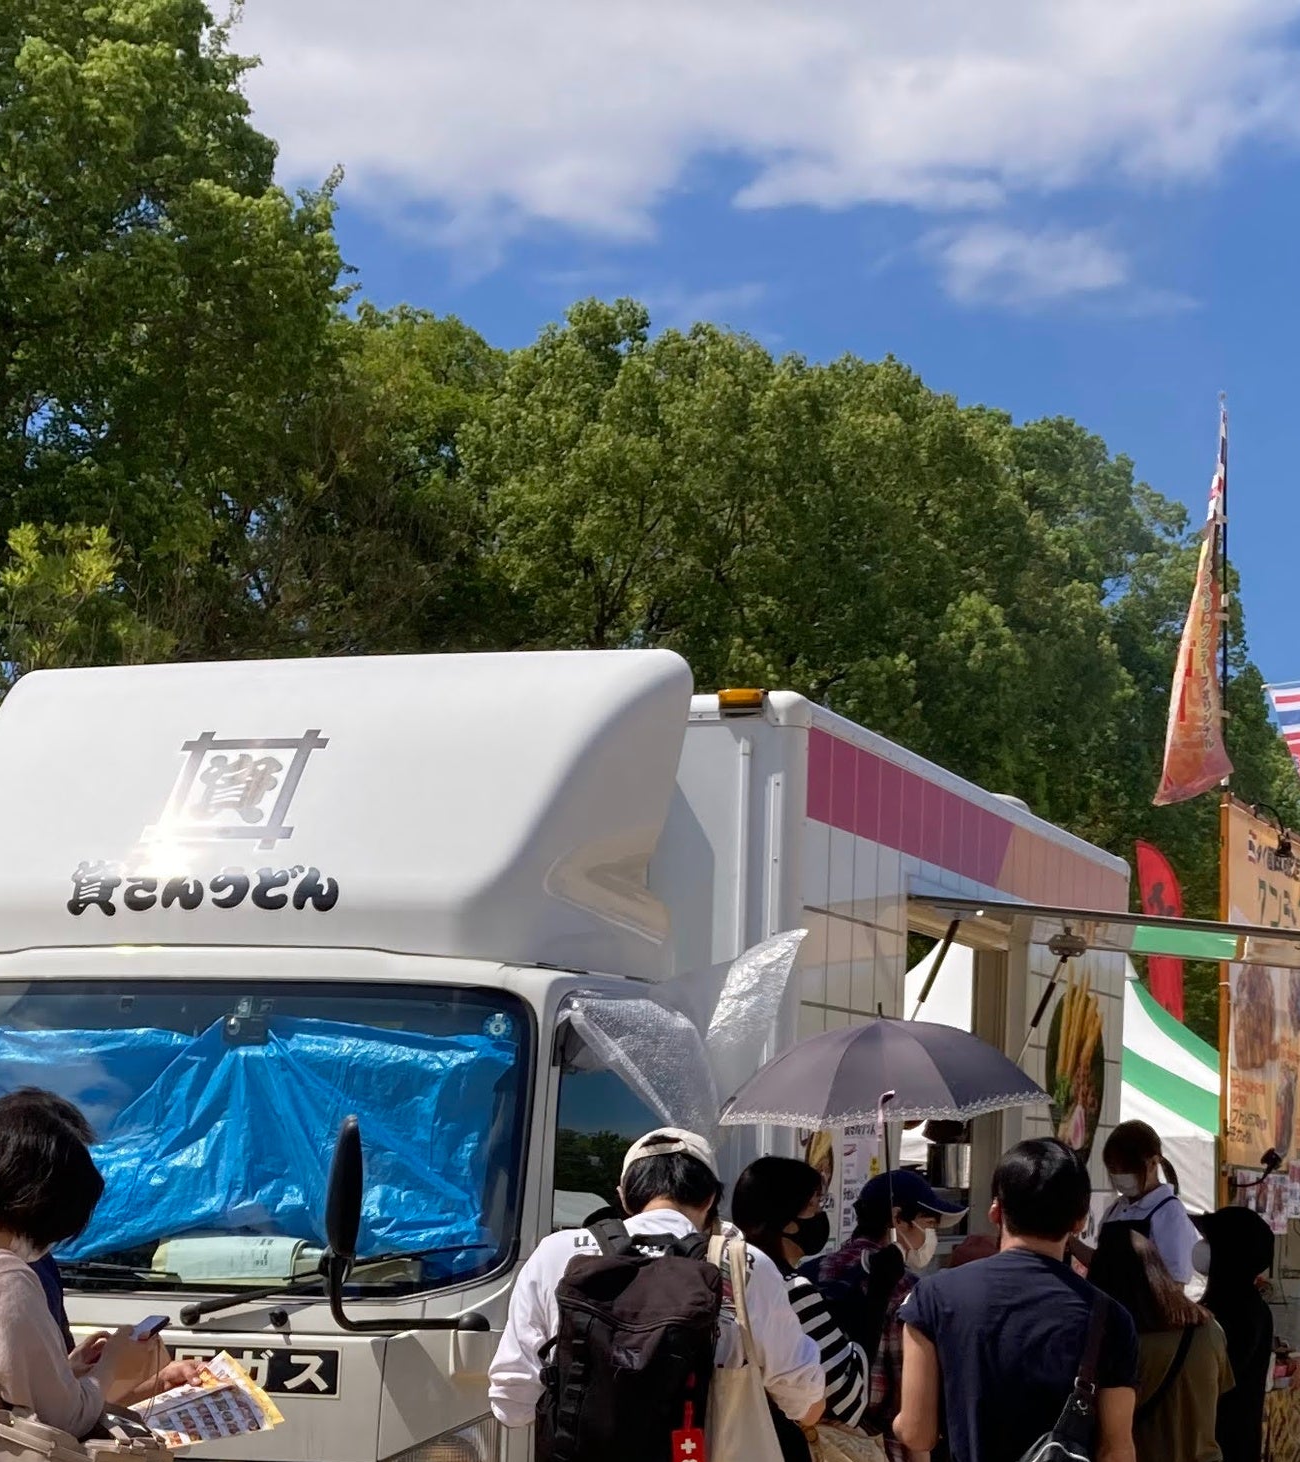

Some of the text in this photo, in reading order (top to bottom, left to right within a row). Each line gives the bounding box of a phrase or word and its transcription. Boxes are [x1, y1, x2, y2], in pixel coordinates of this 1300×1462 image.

[191, 754, 283, 824] 資
[67, 858, 340, 916] 資さんうどん
